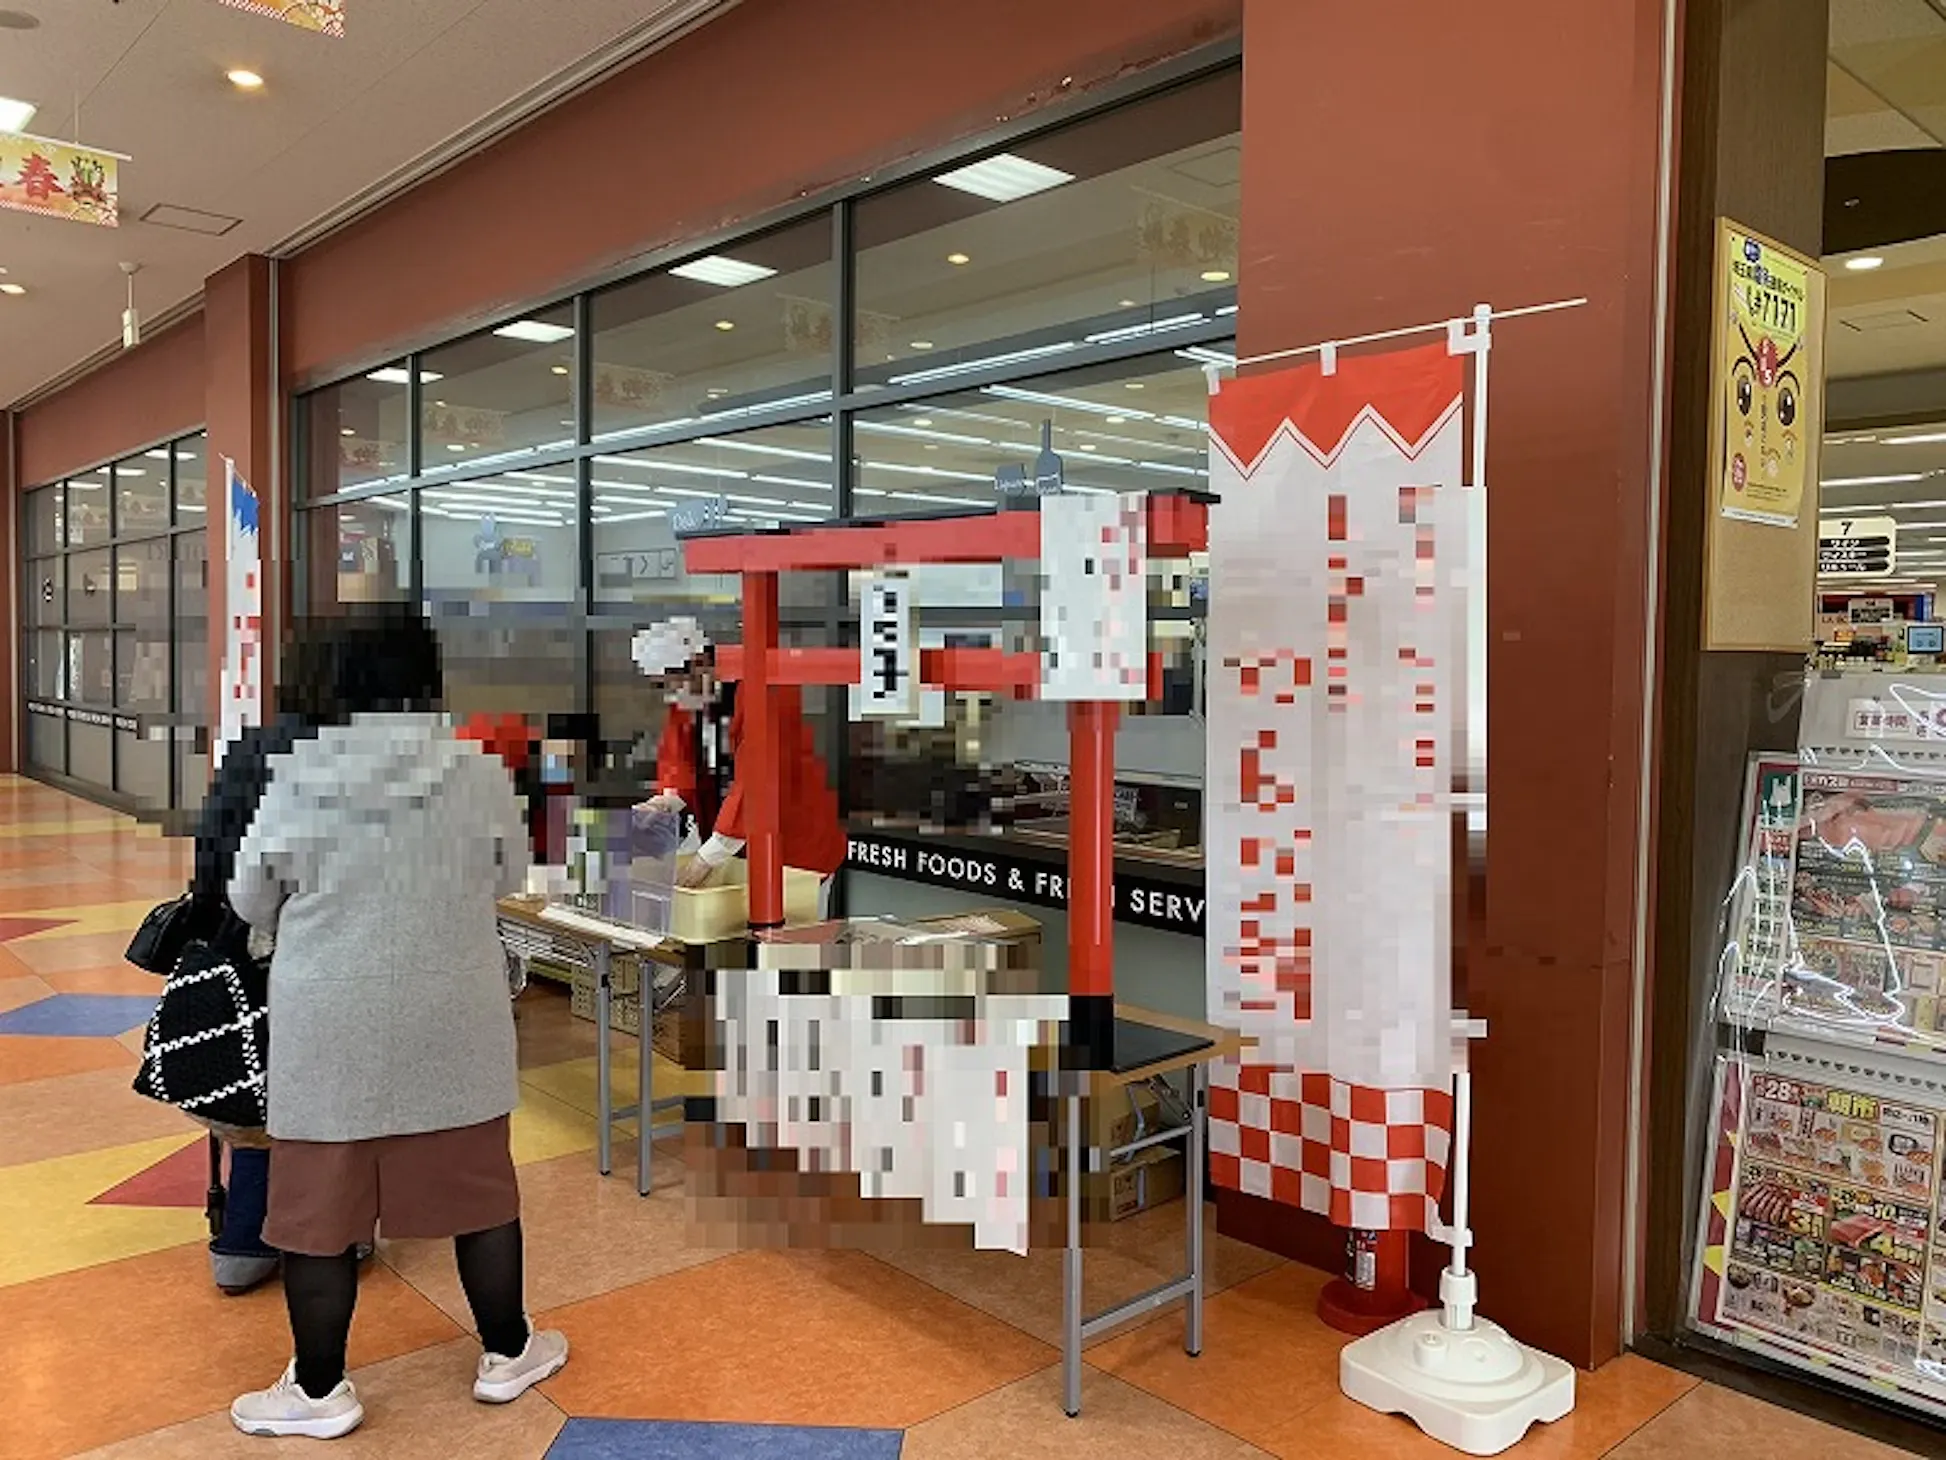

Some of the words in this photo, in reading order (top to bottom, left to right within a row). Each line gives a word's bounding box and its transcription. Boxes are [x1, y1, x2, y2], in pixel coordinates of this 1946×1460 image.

[0, 151, 65, 200] 春
[1841, 521, 1853, 535] 7
[847, 840, 907, 871] FRESH
[917, 850, 997, 885] FOODS
[1008, 867, 1026, 892] &
